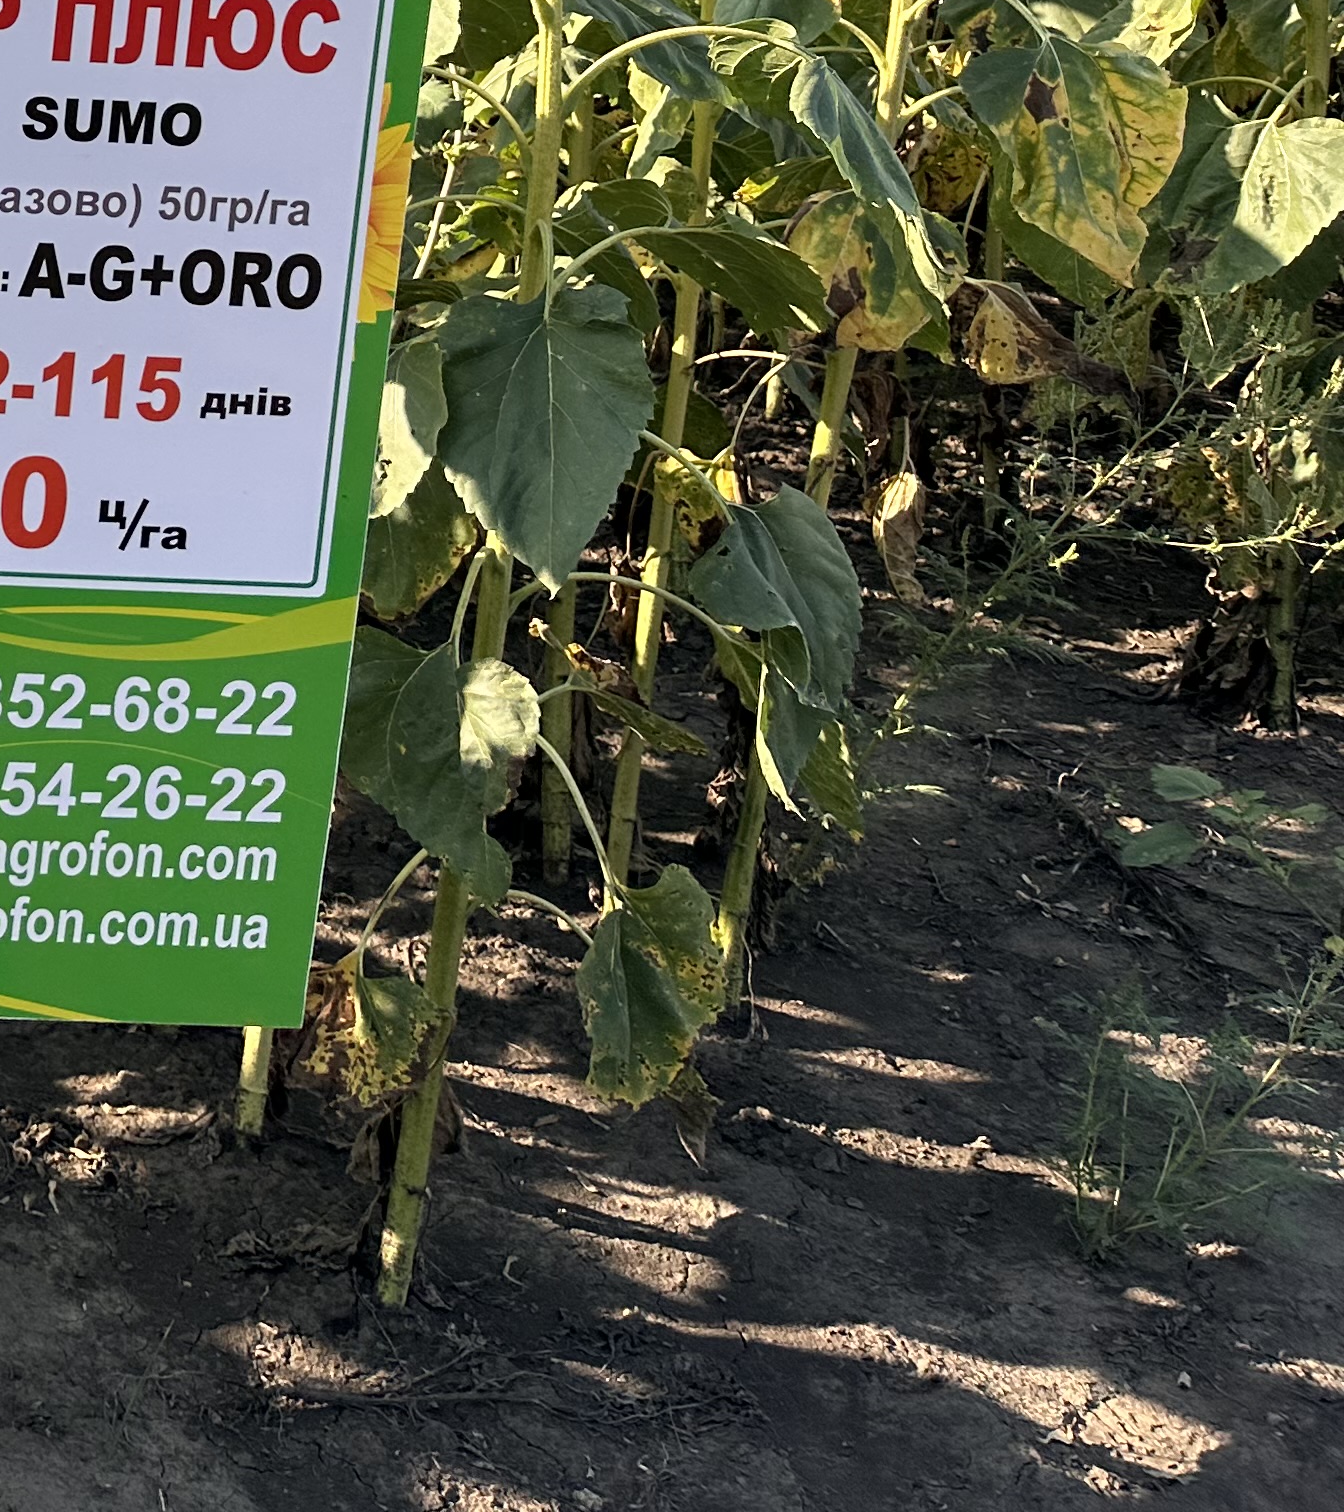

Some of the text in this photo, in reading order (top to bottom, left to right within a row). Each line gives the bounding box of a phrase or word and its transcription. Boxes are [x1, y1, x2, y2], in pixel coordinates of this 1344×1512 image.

[22, 97, 202, 146] SUMO
[159, 186, 309, 232] 50гр/га
[18, 243, 322, 310] A-G+ORO
[200, 387, 291, 419] днів
[99, 499, 187, 551] ц/га
